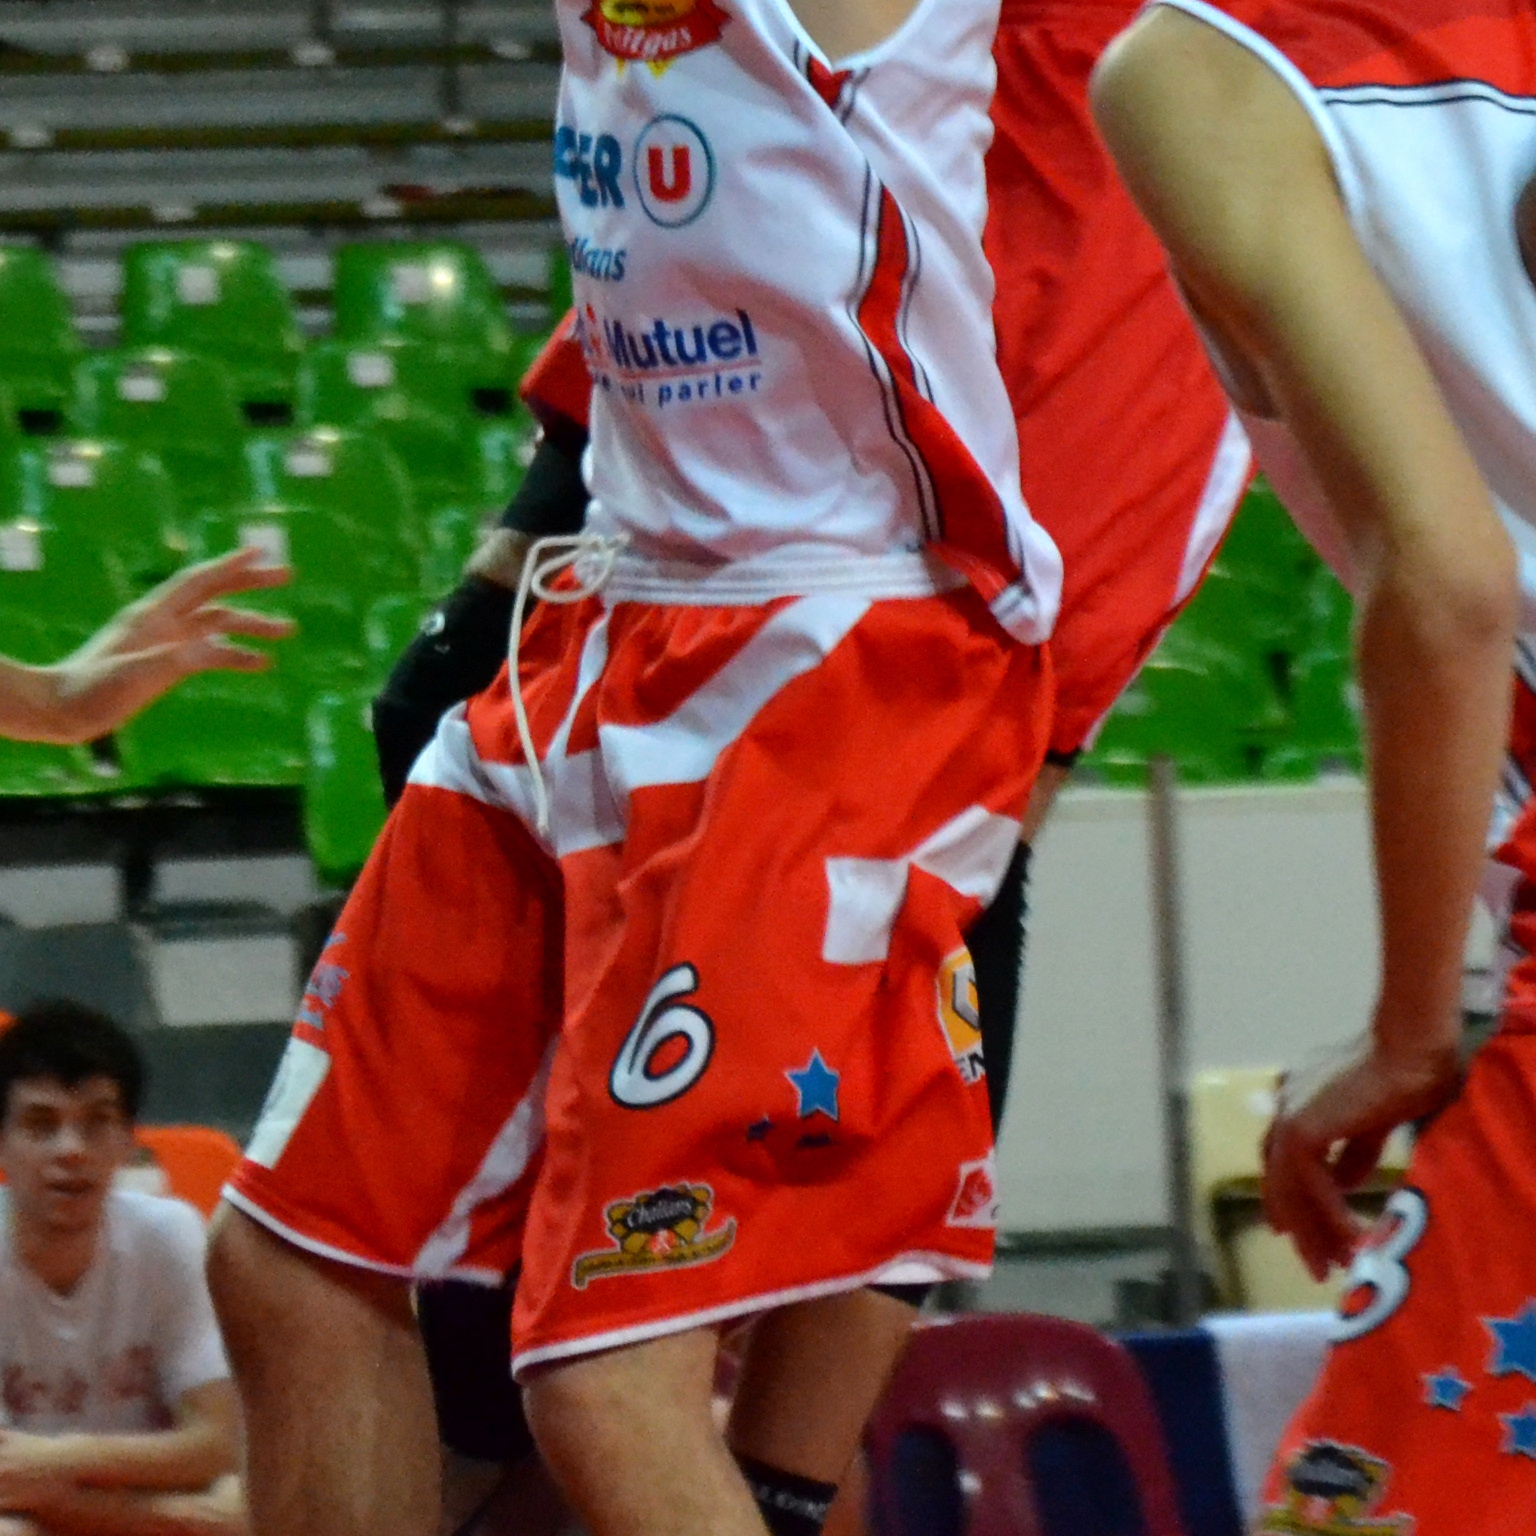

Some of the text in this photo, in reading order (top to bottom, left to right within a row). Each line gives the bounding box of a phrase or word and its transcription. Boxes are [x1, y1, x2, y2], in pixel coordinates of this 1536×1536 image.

[648, 142, 692, 204] U
[603, 306, 758, 371] Mutuel
[658, 371, 761, 409] parler
[608, 961, 715, 1110] 6
